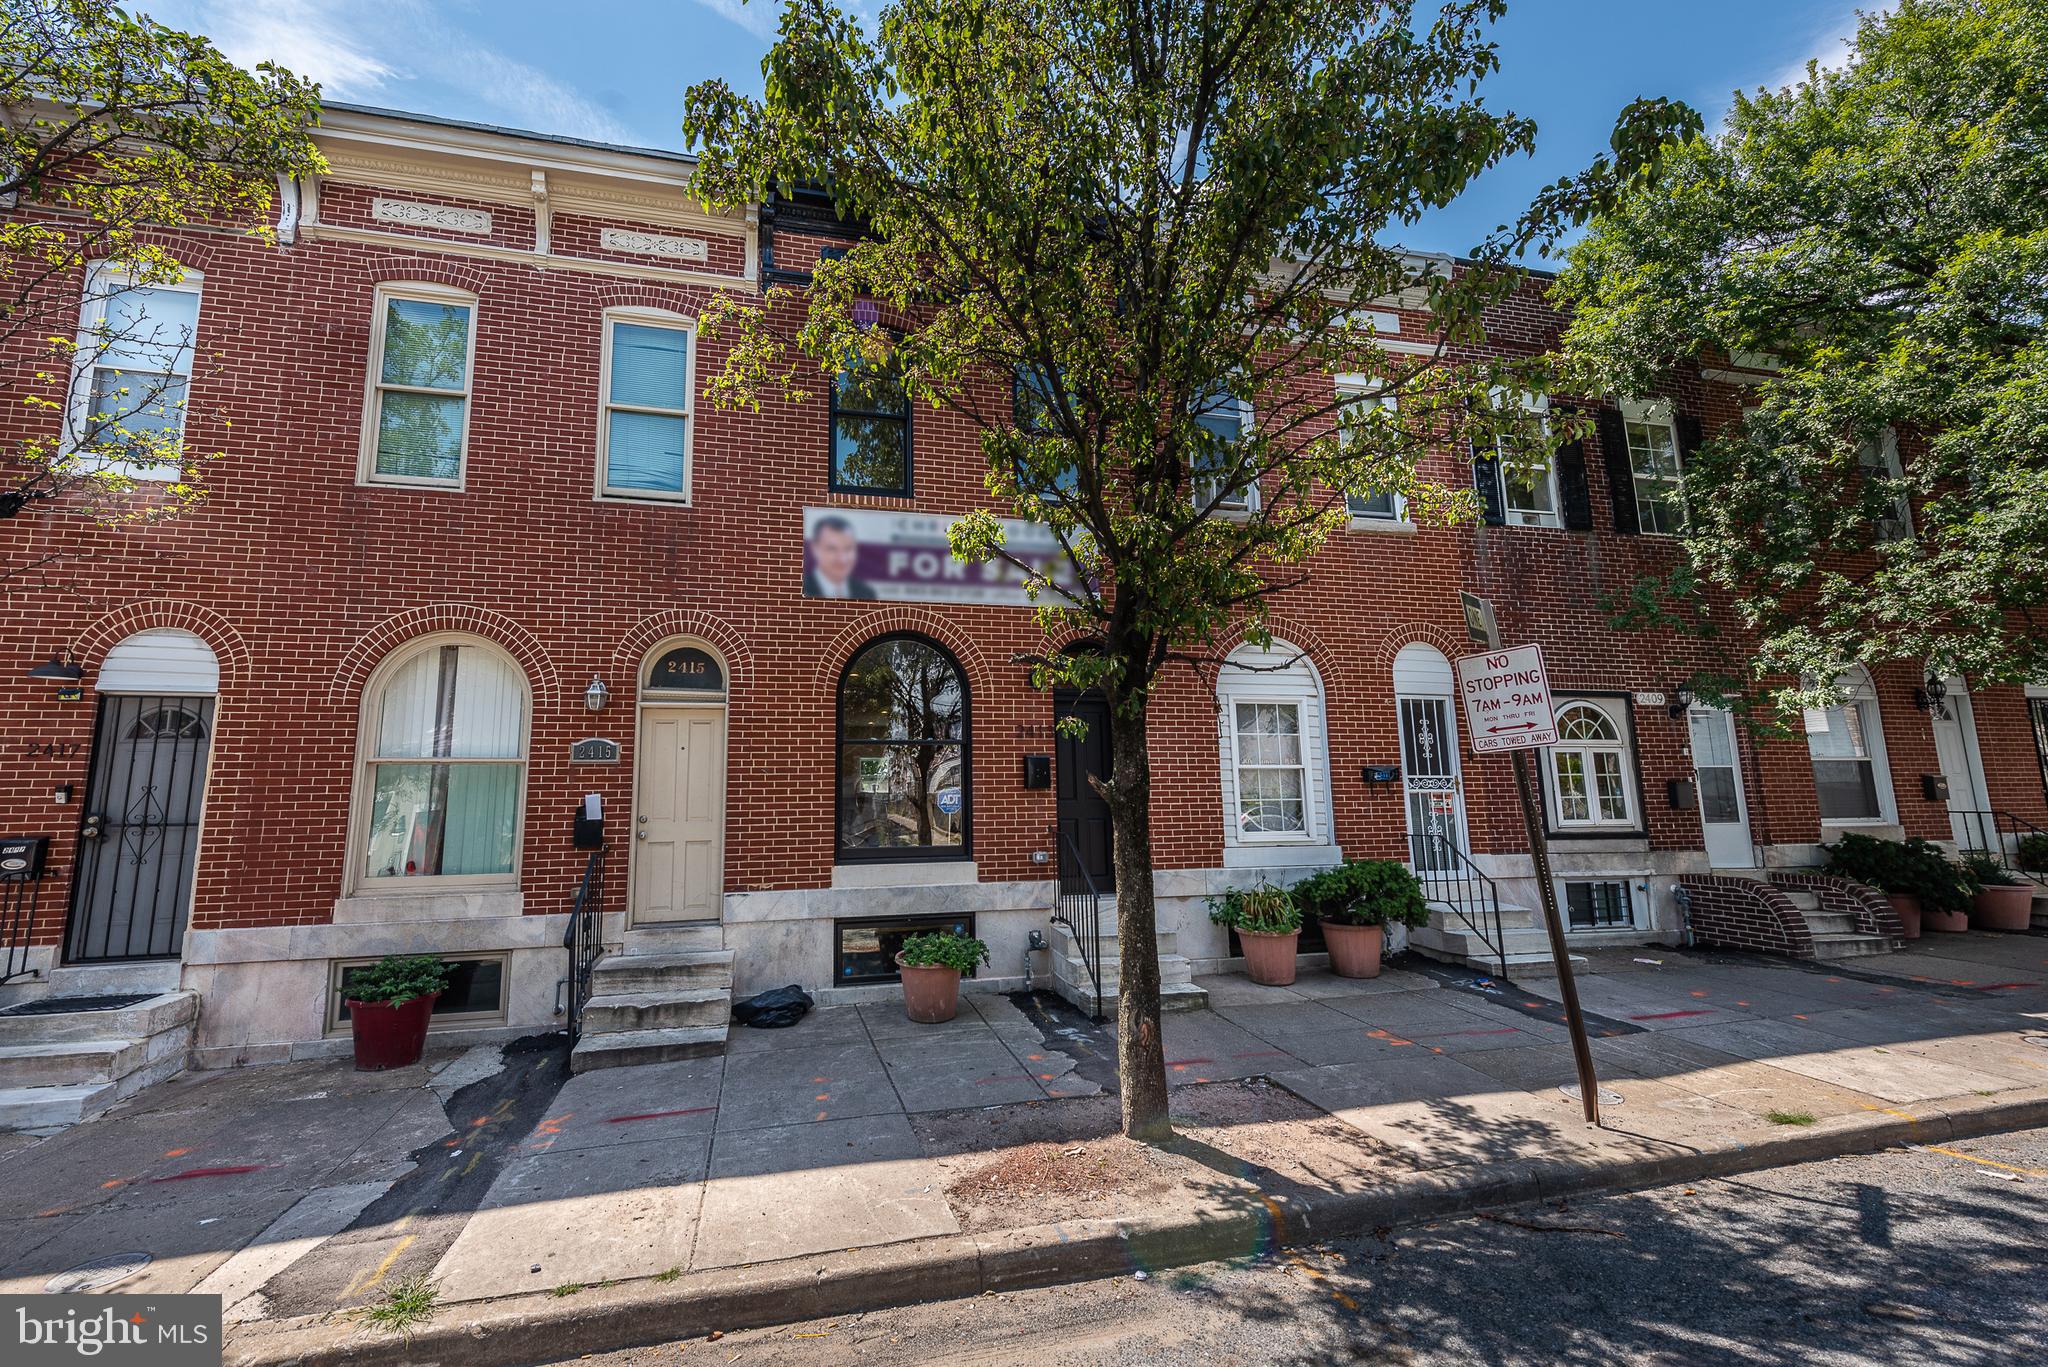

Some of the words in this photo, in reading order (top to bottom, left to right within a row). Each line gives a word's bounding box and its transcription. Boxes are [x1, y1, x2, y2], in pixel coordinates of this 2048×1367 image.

[889, 551, 964, 580] FOR
[668, 660, 705, 674] 2415
[1486, 654, 1509, 670] NO
[1466, 669, 1540, 693] STOPPING
[1639, 693, 1663, 704] 2409
[1478, 738, 1498, 749] CARS
[1501, 735, 1526, 746] TOWED
[1531, 732, 1552, 743] AWAY
[27, 743, 80, 758] 2417
[579, 745, 611, 759] 2415
[940, 794, 961, 805] ADT
